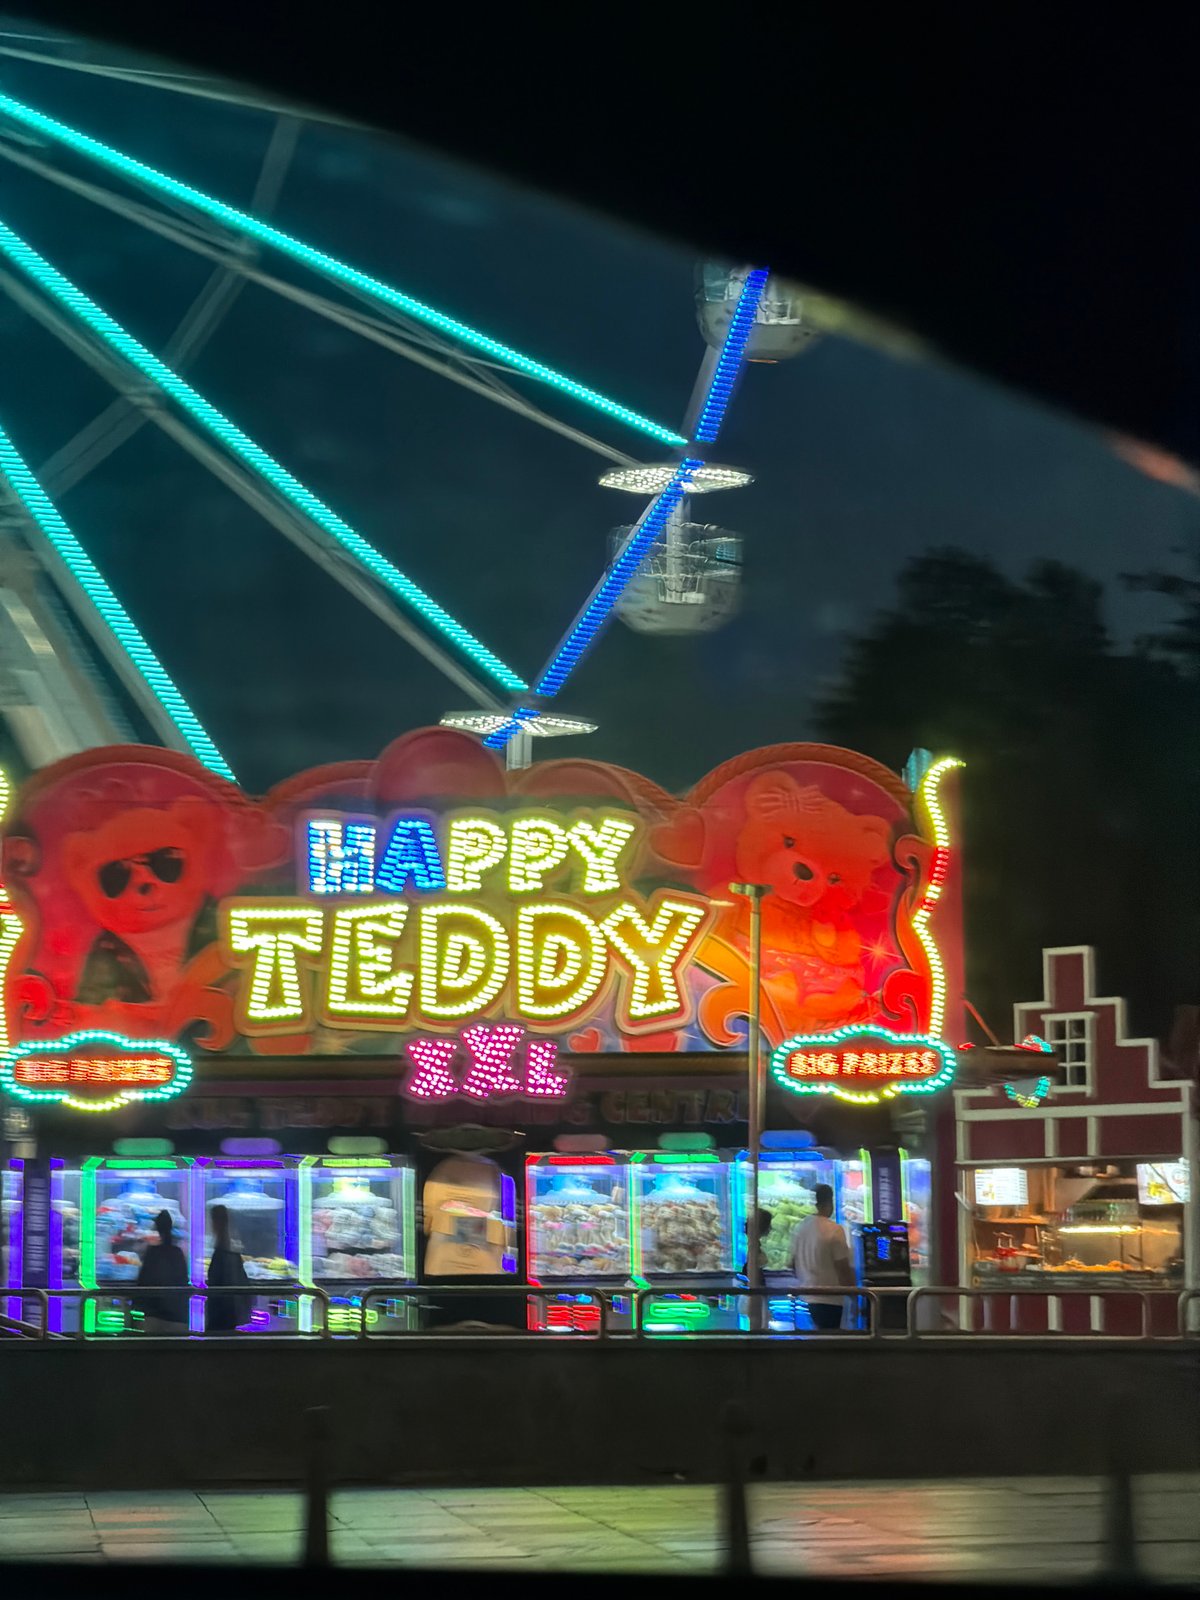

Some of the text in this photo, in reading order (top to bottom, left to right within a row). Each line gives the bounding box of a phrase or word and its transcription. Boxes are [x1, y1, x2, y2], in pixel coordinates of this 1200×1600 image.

[308, 819, 634, 893] HAPPY
[230, 901, 703, 1018] TEDDY
[407, 1025, 567, 1096] XXL
[791, 1051, 936, 1075] BIG PRIZES
